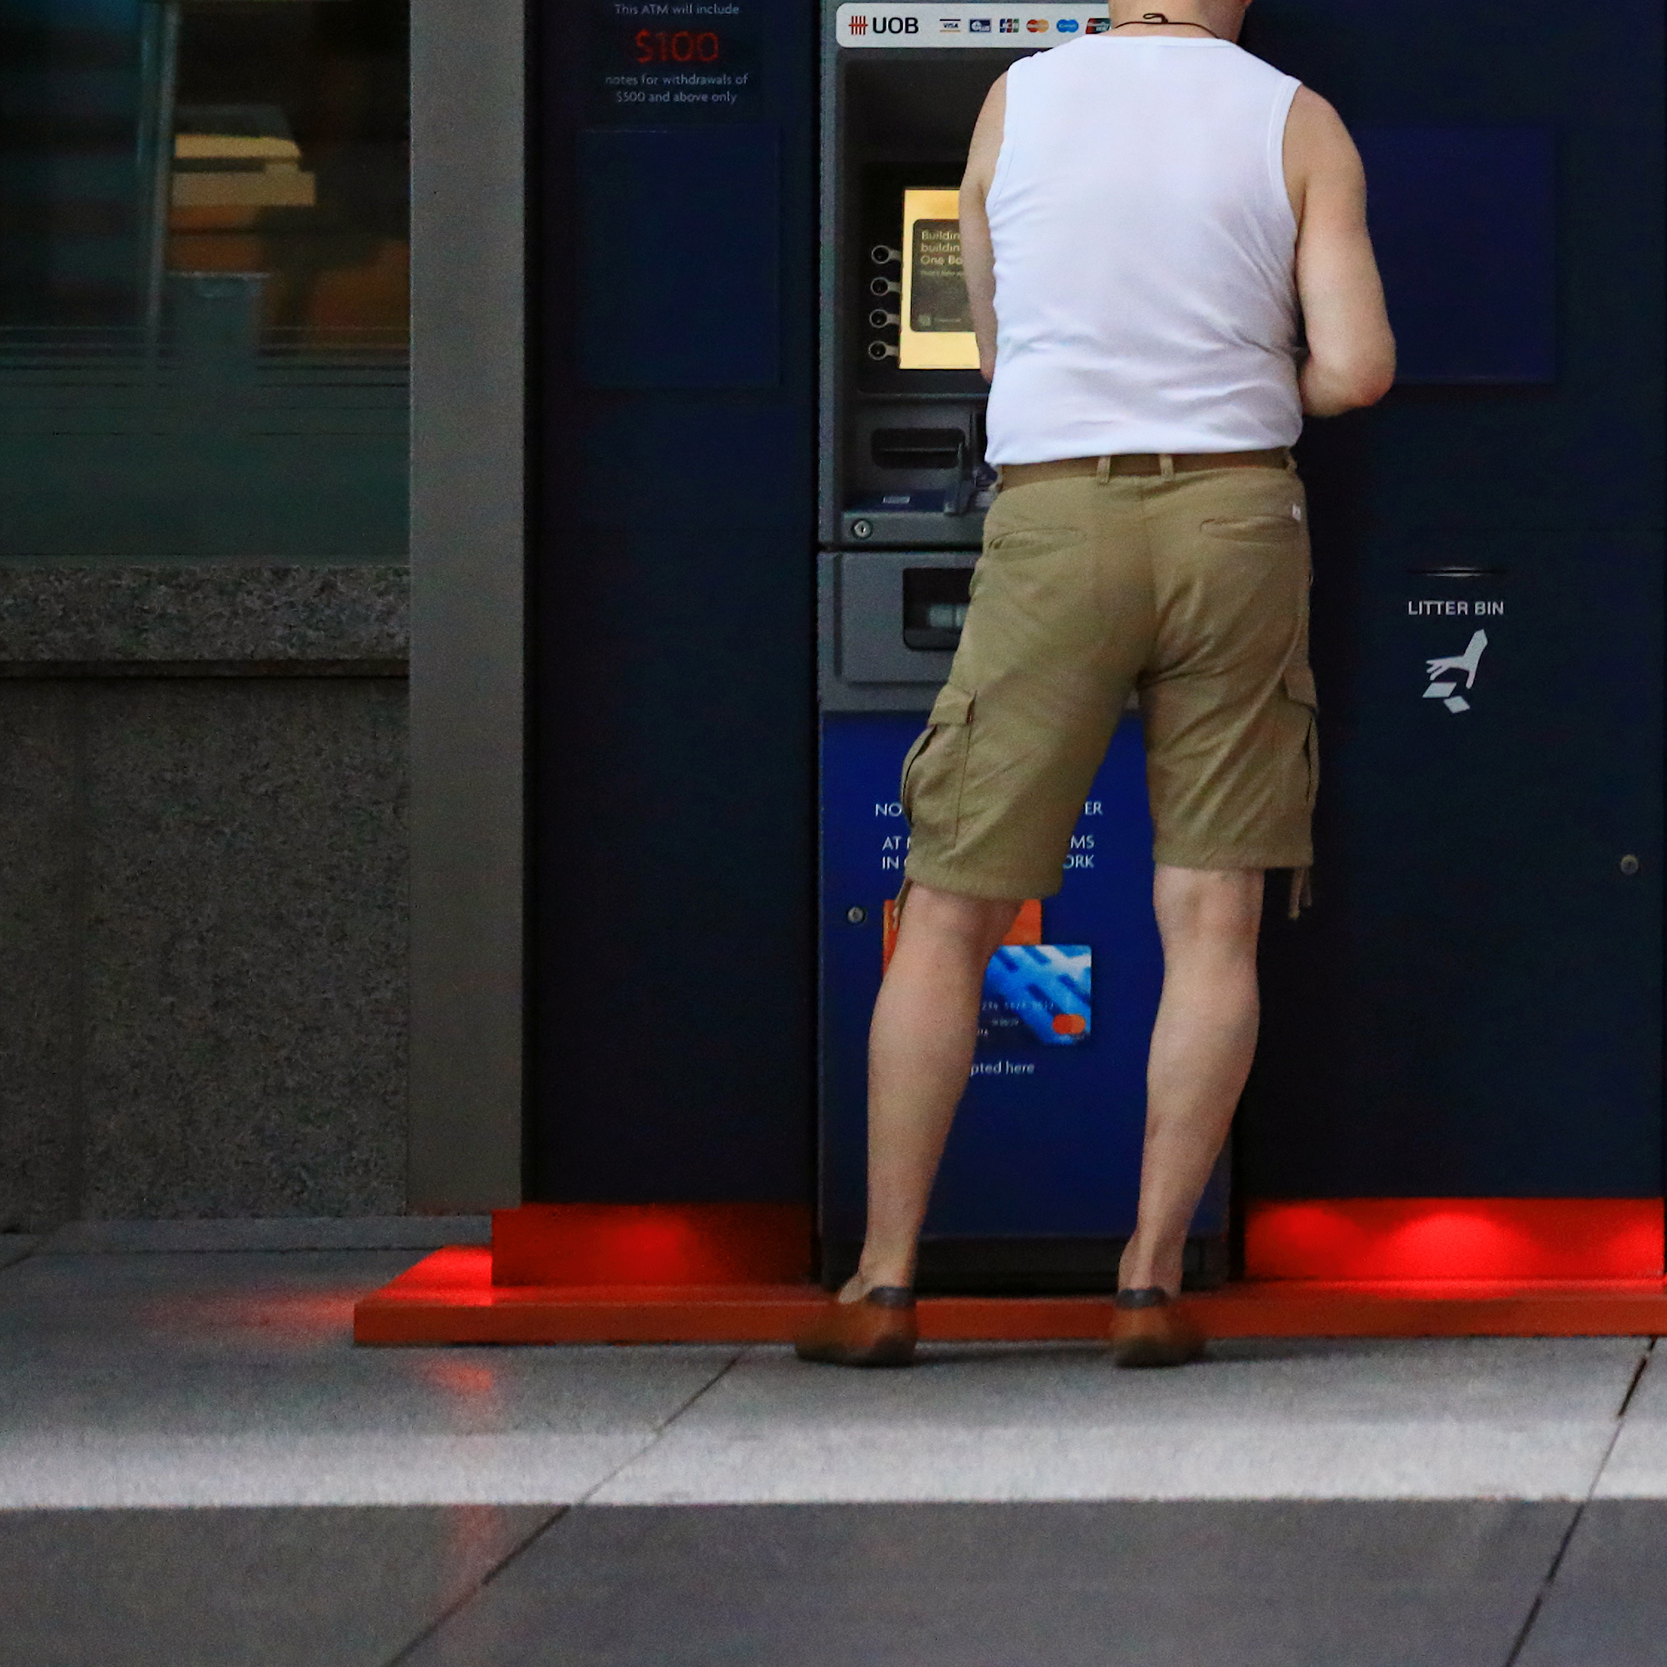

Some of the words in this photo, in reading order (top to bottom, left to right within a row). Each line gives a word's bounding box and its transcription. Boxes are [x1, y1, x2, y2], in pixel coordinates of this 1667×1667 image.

[614, 4, 638, 15] This
[641, 4, 669, 15] ATM
[672, 3, 693, 15] will
[697, 3, 740, 15] include
[872, 17, 919, 34] UOB
[636, 28, 719, 64] $100
[605, 76, 638, 85] notes
[641, 73, 658, 85] for
[662, 74, 732, 85] withdrawals
[735, 73, 749, 85] of
[649, 91, 670, 103] and
[673, 91, 708, 103] above
[711, 91, 738, 105] only
[921, 230, 960, 240] Buildin
[921, 242, 960, 252] buildin
[1407, 600, 1469, 616] LITTER
[1474, 600, 1504, 616] BIN
[875, 802, 903, 817] NO
[882, 836, 900, 850] AT
[881, 856, 899, 870] IN
[1006, 1060, 1035, 1075] here
